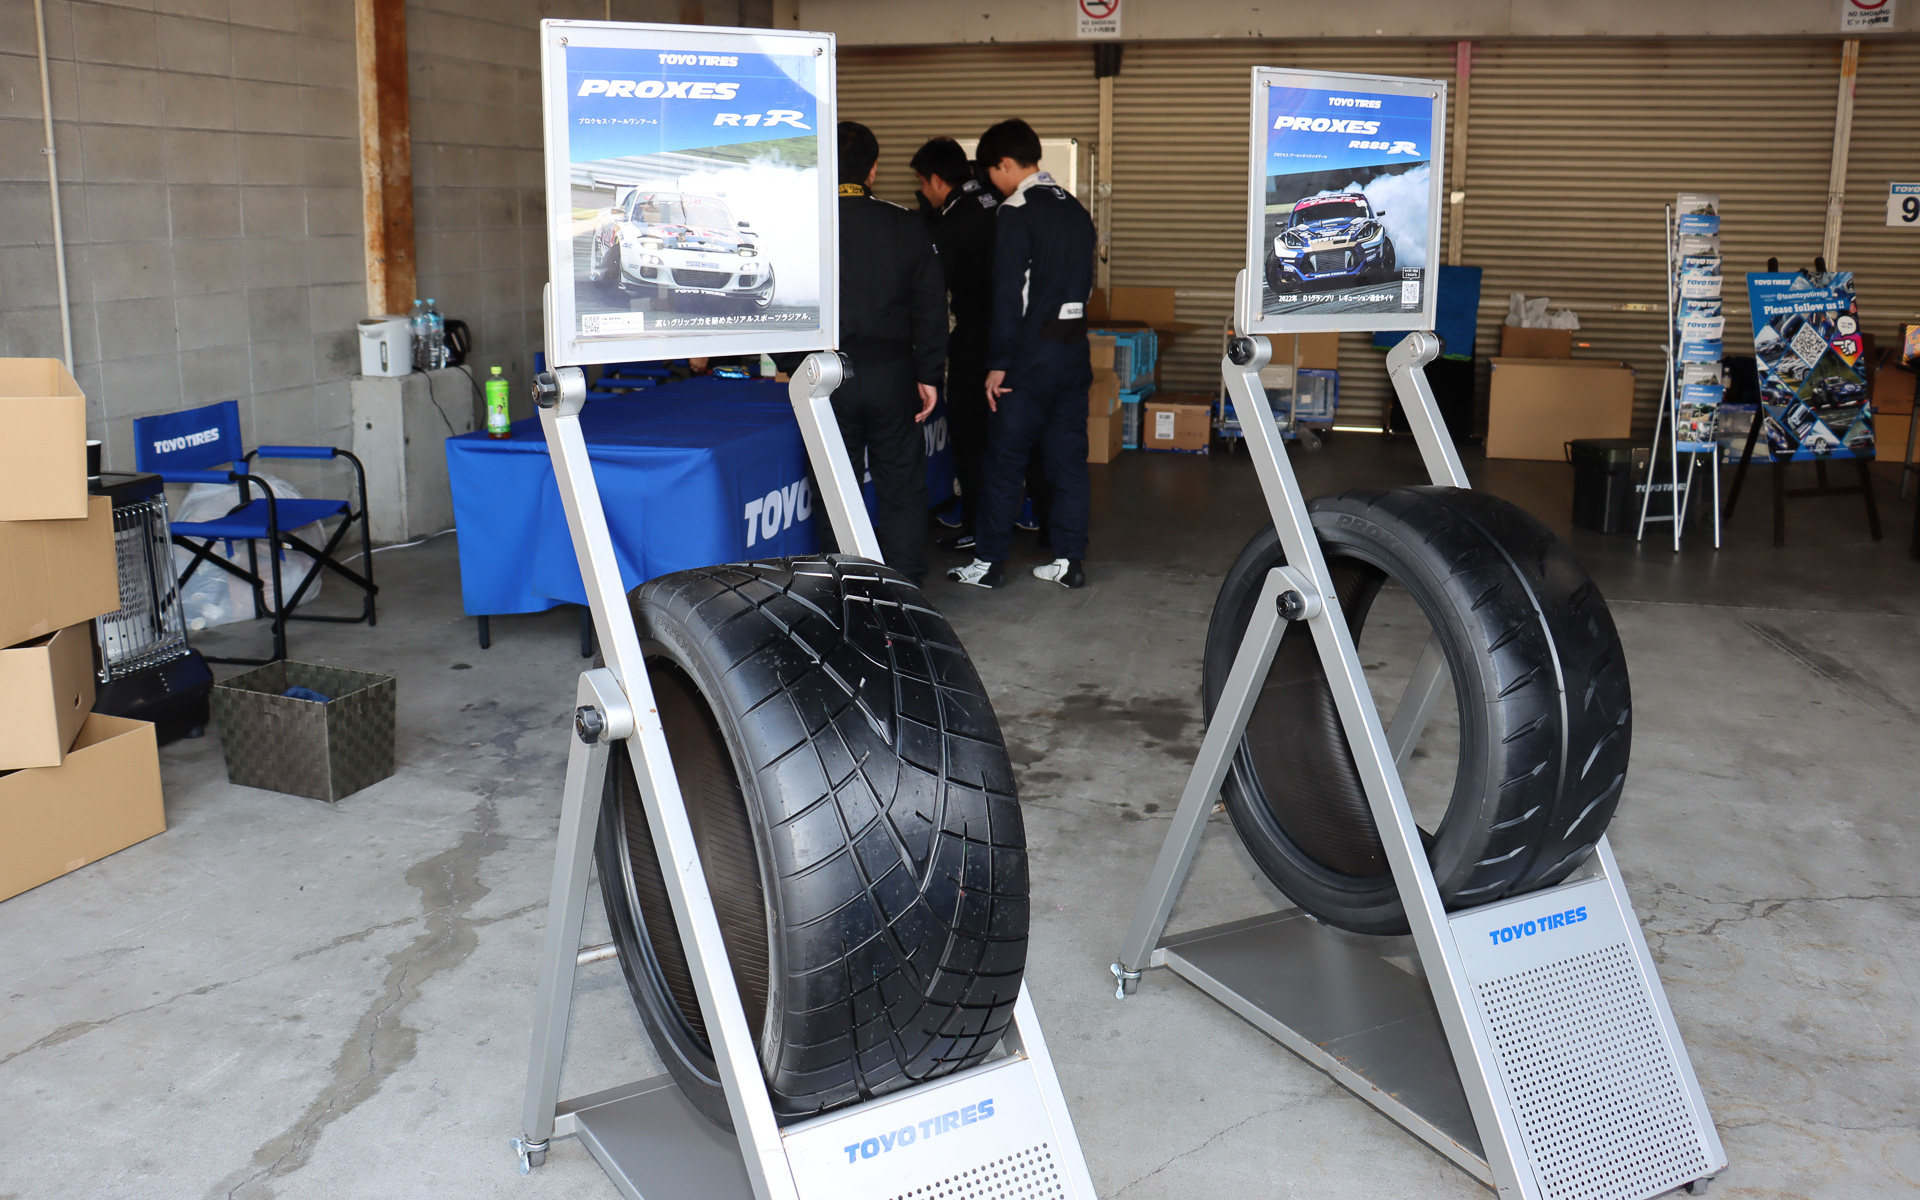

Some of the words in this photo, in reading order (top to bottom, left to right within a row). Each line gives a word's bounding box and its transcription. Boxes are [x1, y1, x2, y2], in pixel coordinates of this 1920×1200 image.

[1859, 9, 1890, 17] SMOKING
[659, 54, 697, 66] TOYO
[698, 55, 739, 67] TIRES
[577, 79, 741, 100] PROXES
[1329, 97, 1354, 107] TOYO
[1355, 99, 1382, 109] TIRES
[1273, 115, 1381, 135] PROXES
[1901, 196, 1920, 222] 9
[1764, 304, 1793, 315] Please
[1795, 301, 1824, 312] follow
[154, 437, 186, 454] TOYO
[185, 427, 220, 447] TIRES
[744, 476, 812, 548] TOYO
[1489, 921, 1537, 946] TOYO
[1537, 906, 1587, 933] TIRES
[844, 1125, 916, 1164] TOYO
[918, 1098, 995, 1139] TIRES
